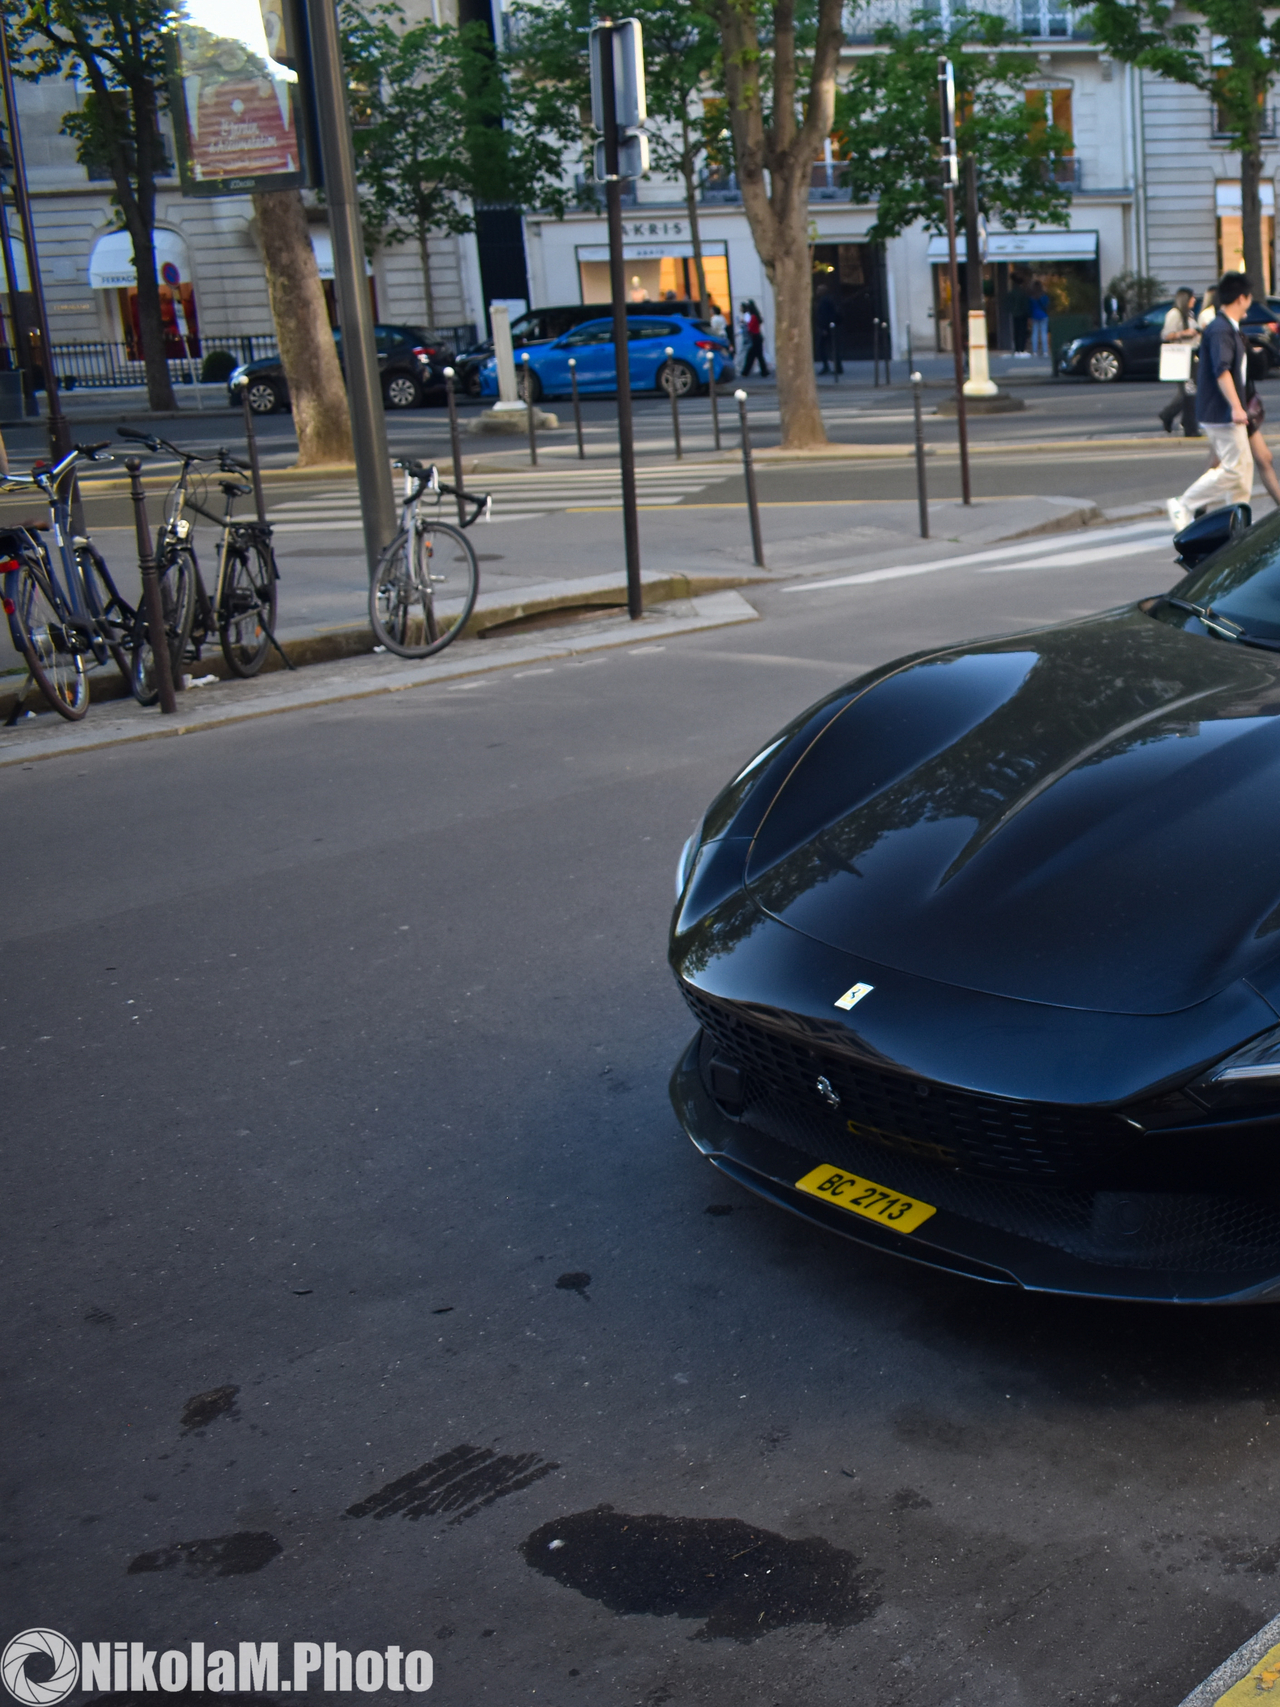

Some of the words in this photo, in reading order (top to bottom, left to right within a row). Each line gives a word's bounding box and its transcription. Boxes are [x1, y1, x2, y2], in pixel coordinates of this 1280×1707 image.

[621, 222, 682, 236] AKRIS
[817, 1173, 856, 1196] BC
[849, 1188, 913, 1220] 2713
